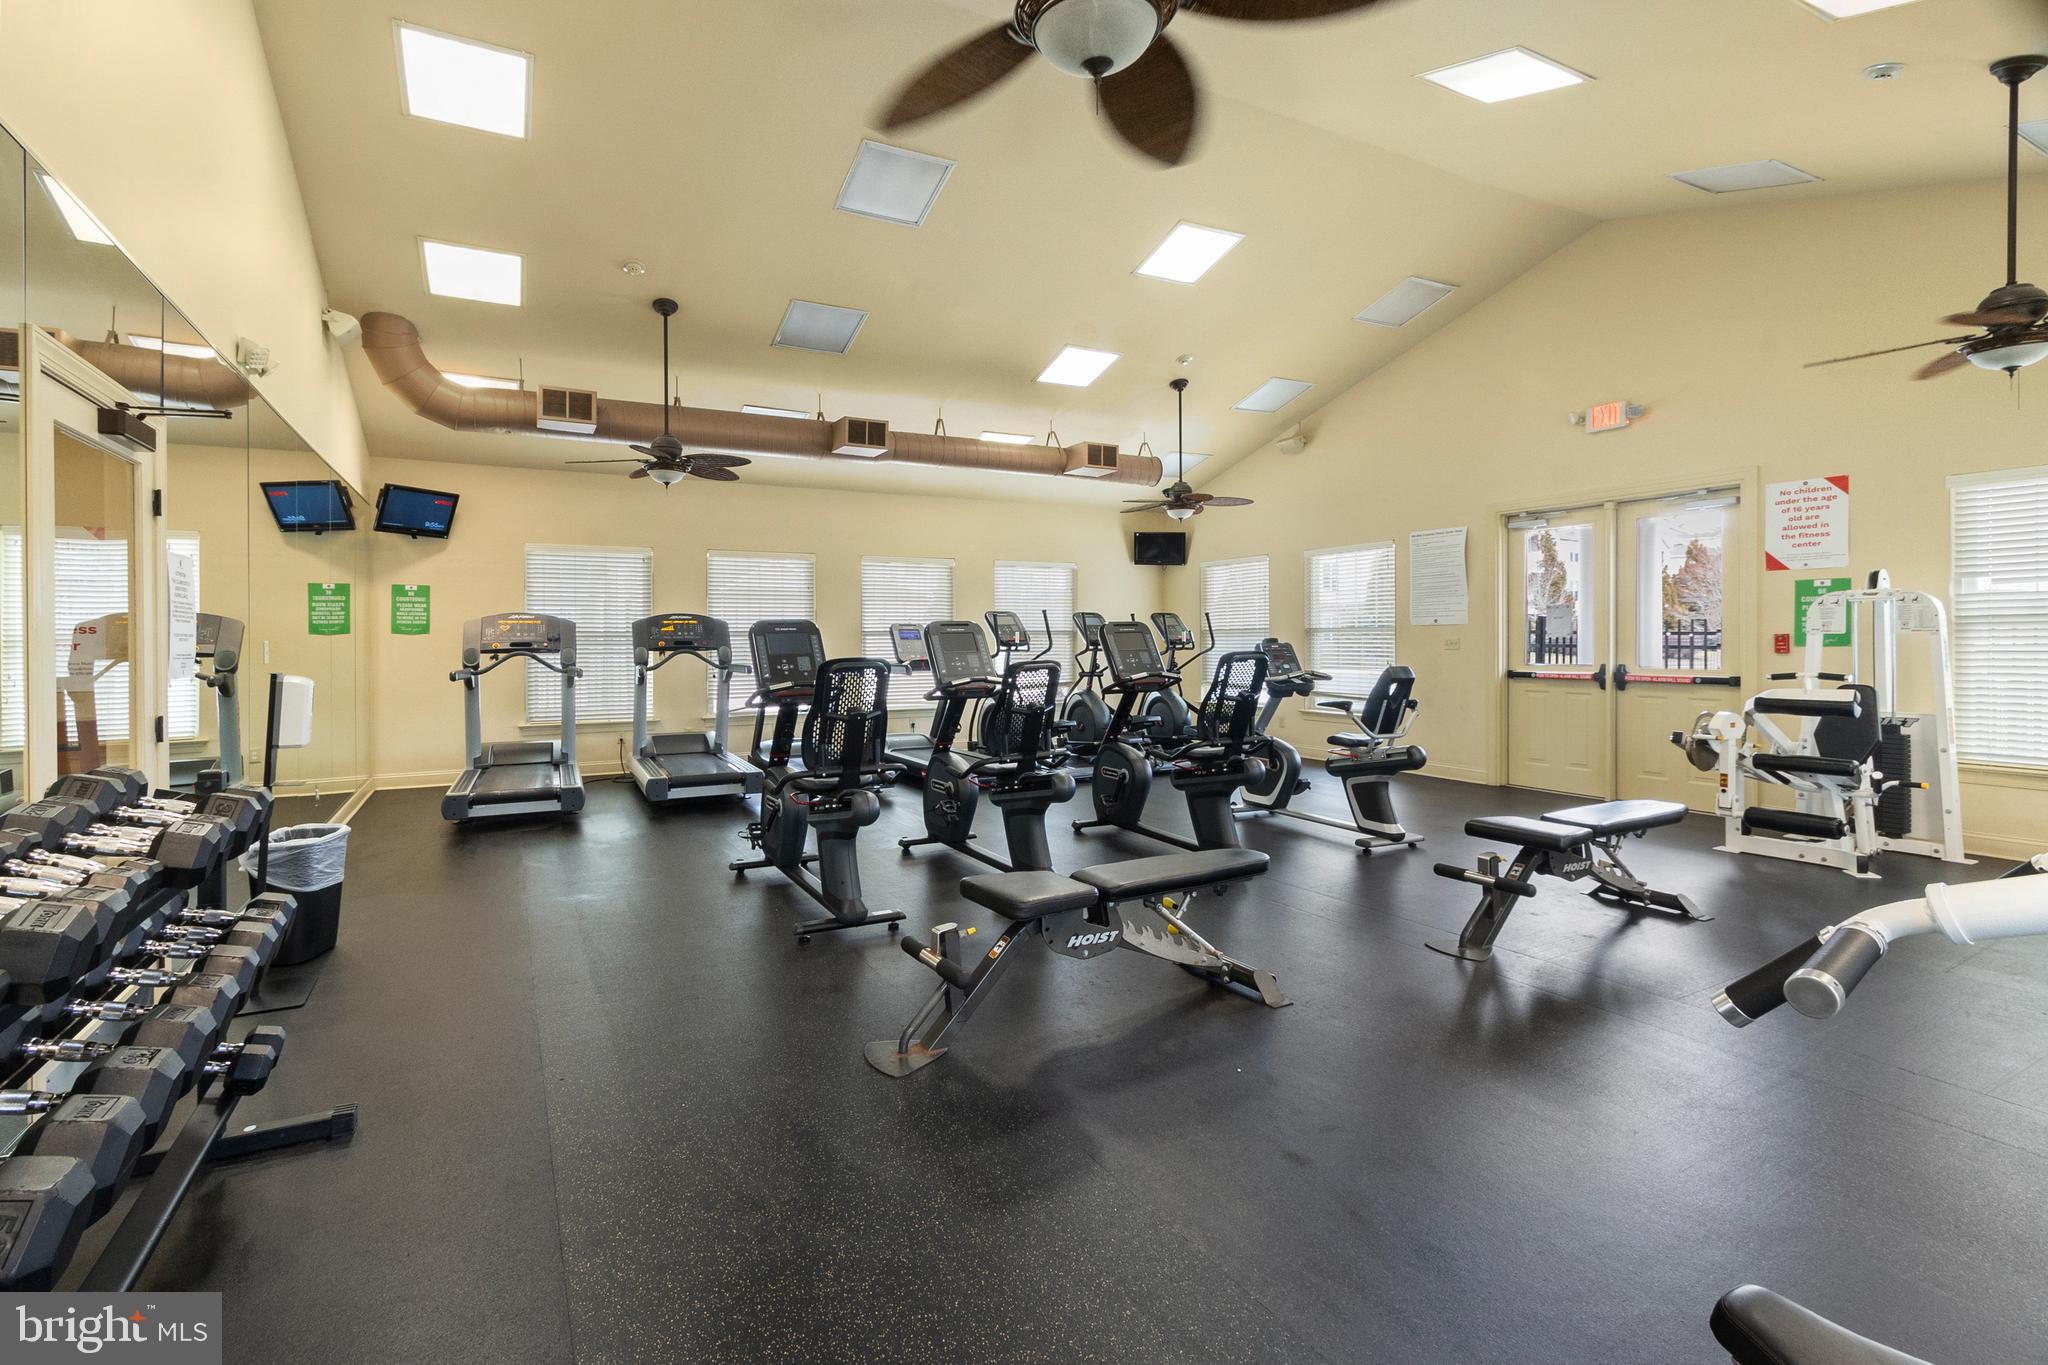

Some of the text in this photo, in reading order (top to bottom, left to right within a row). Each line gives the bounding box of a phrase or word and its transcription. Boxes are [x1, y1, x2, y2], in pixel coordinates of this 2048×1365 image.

[1794, 486, 1832, 495] children
[1775, 498, 1800, 506] under
[1821, 494, 1838, 502] age
[1804, 504, 1830, 513] years
[1782, 523, 1818, 531] allowed
[1798, 531, 1831, 539] fitness
[1562, 861, 1591, 872] HOIST
[1067, 931, 1119, 947] HOIST
